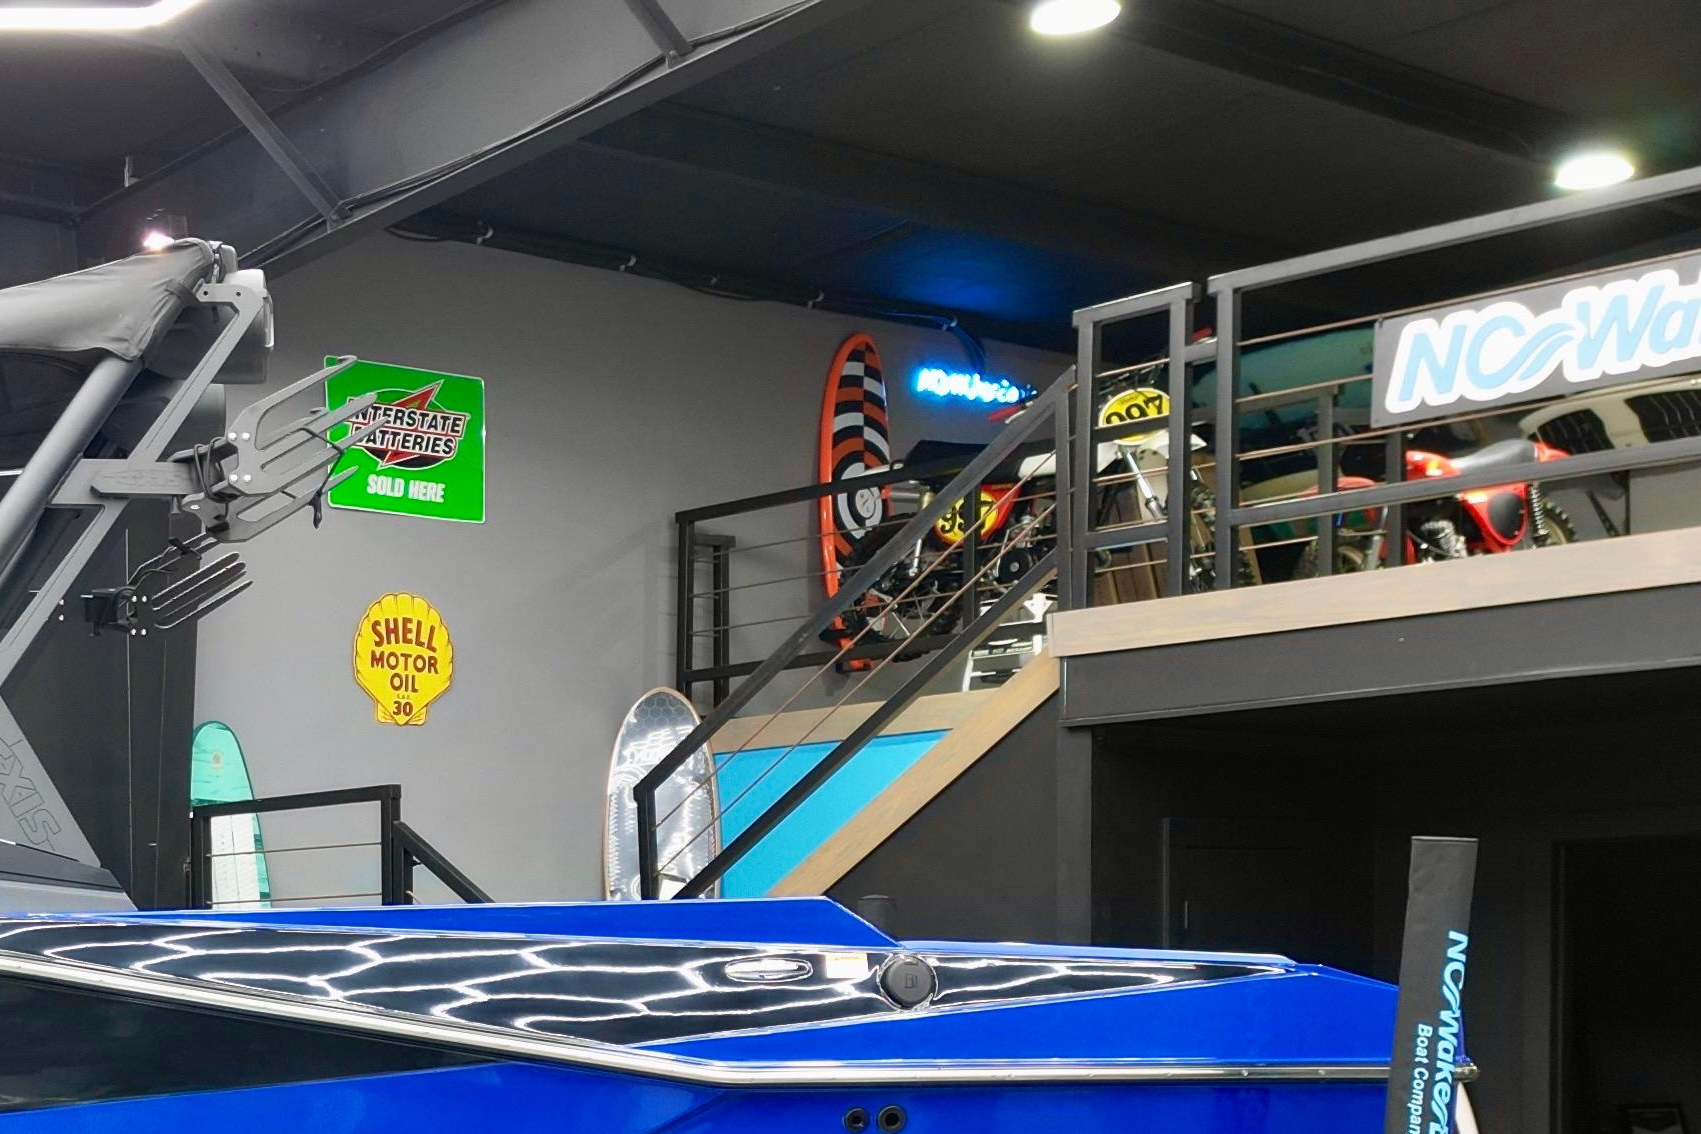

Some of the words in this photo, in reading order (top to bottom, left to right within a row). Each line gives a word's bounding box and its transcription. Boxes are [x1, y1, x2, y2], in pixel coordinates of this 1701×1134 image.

[348, 398, 462, 434] NTERSTATE
[354, 427, 454, 455] ATTERIES
[366, 474, 405, 497] SOLD
[408, 480, 446, 502] HERE
[371, 616, 437, 653] SHELL
[370, 650, 439, 674] MOTOR
[390, 672, 419, 693] OIL
[392, 701, 413, 716] 30
[1417, 1022, 1434, 1063] Boat
